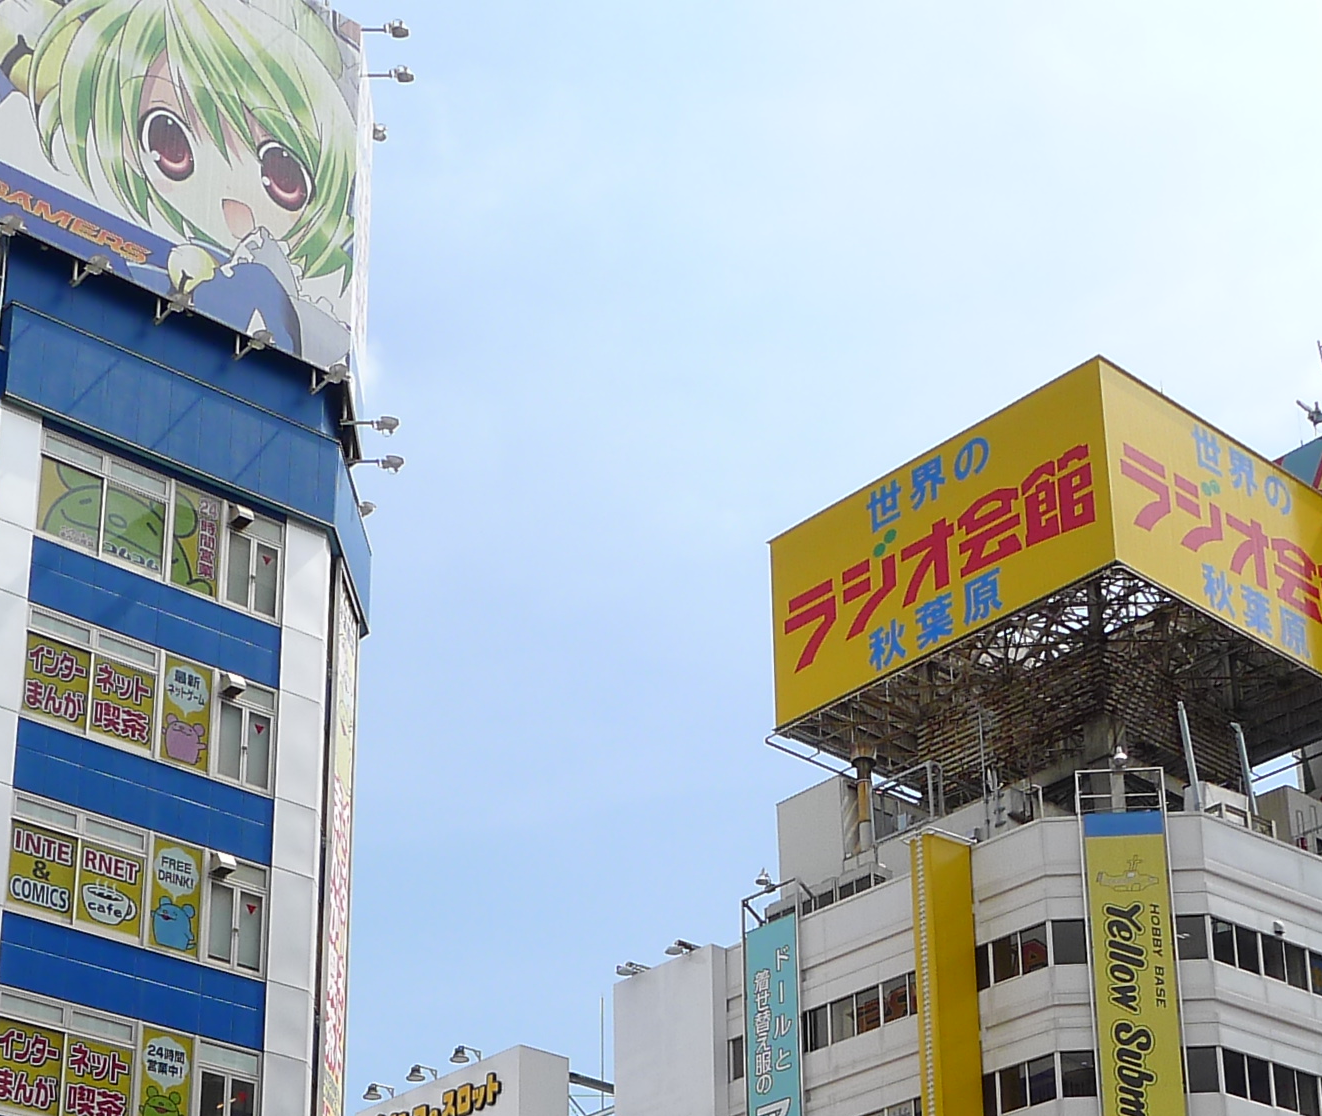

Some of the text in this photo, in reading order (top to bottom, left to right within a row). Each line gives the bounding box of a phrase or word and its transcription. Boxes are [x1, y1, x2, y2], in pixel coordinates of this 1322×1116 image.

[866, 436, 990, 532] 世界の
[1190, 424, 1293, 516] 世界の
[784, 443, 1096, 674] ラジオ会館
[868, 567, 1004, 671] 秋葉原
[1202, 564, 1312, 660] 秋葉原
[172, 668, 202, 691] 最新
[9, 876, 70, 914] COMICS
[87, 898, 123, 920] cafe
[161, 854, 193, 876] FREE
[1103, 902, 1149, 1015] Yellow
[1148, 903, 1167, 1008] HOBBY BASE
[147, 1043, 186, 1065] 24時間
[752, 967, 773, 1097] 着せ替え服の
[775, 943, 793, 1074] ドールと
